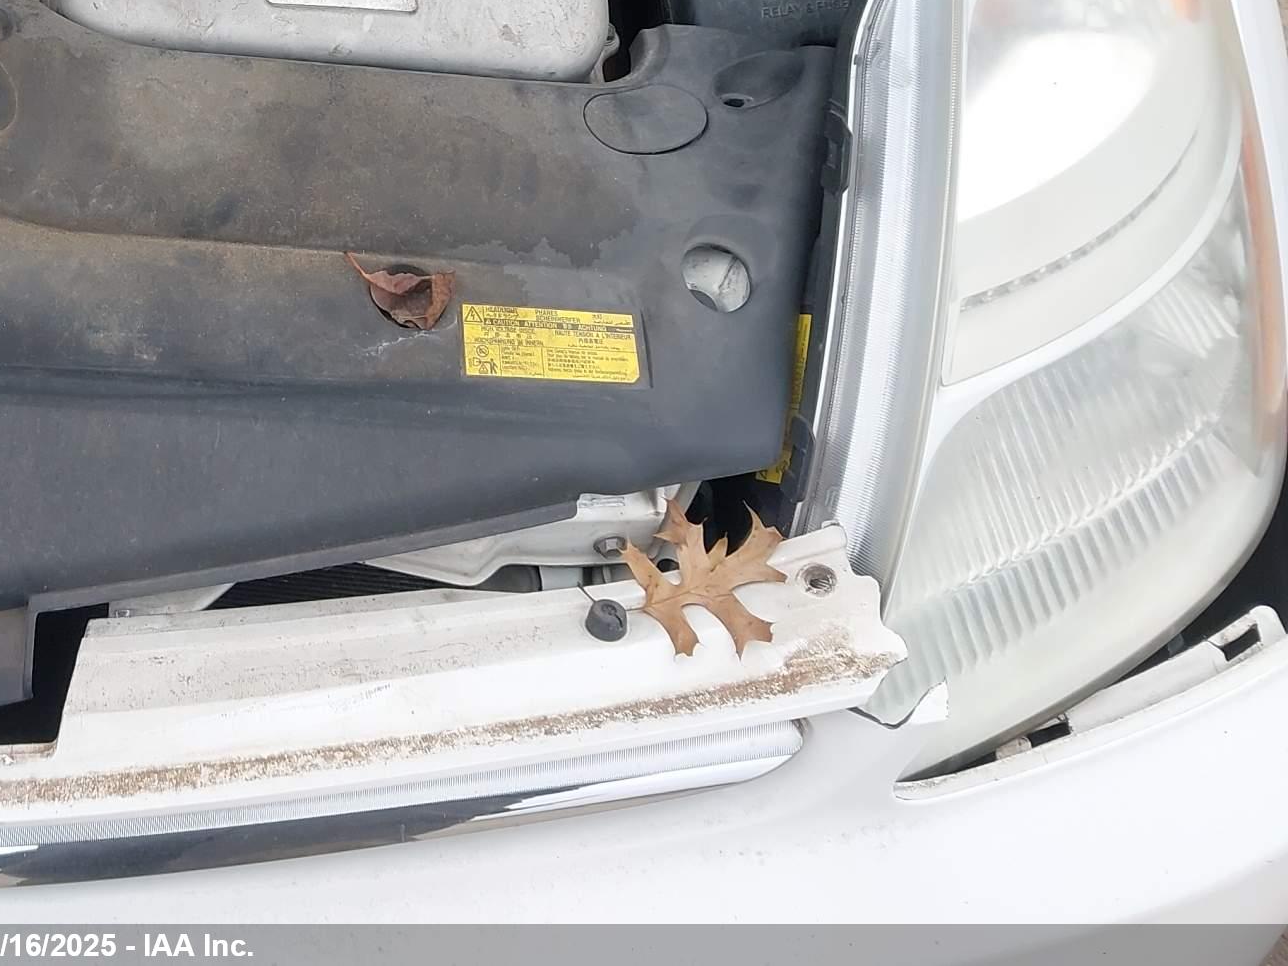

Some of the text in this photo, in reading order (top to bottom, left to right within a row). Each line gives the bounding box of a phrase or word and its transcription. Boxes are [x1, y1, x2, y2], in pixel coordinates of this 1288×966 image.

[761, 2, 800, 19] RELAY
[494, 319, 519, 327] CAUTION
[524, 321, 557, 329] ATTENTION
